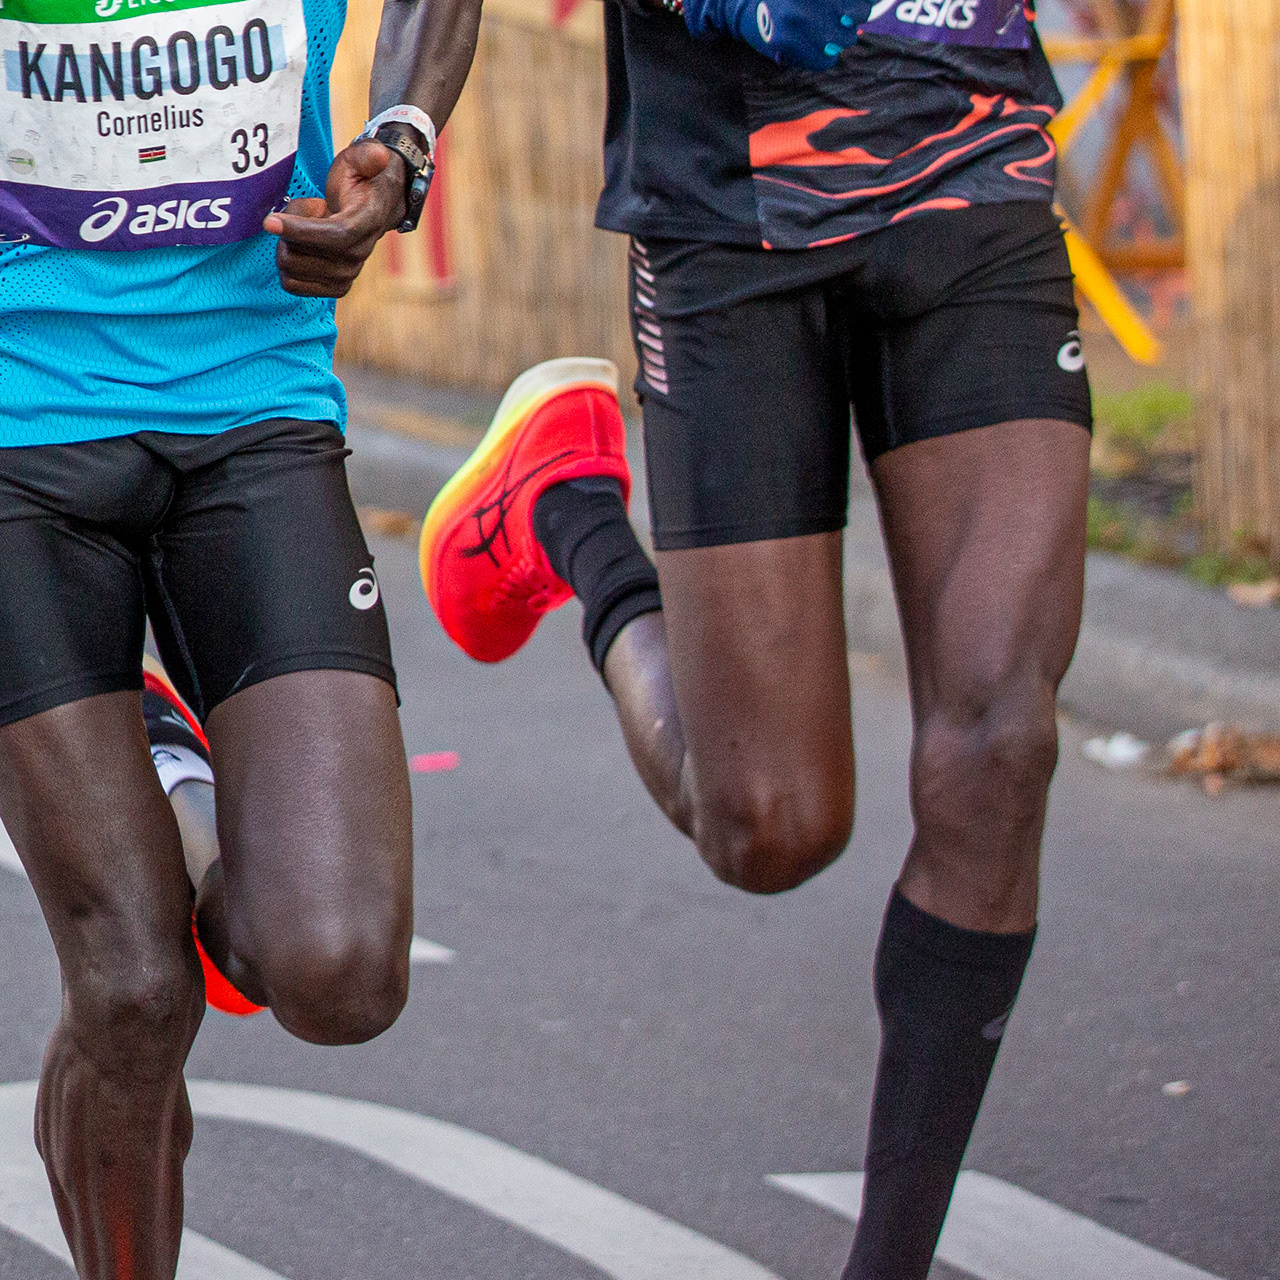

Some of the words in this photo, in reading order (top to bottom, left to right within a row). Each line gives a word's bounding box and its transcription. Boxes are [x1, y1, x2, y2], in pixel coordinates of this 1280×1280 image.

[18, 17, 272, 103] KANGOGO
[96, 105, 204, 137] Cornelius
[230, 122, 269, 174] 33
[129, 197, 230, 235] asics
